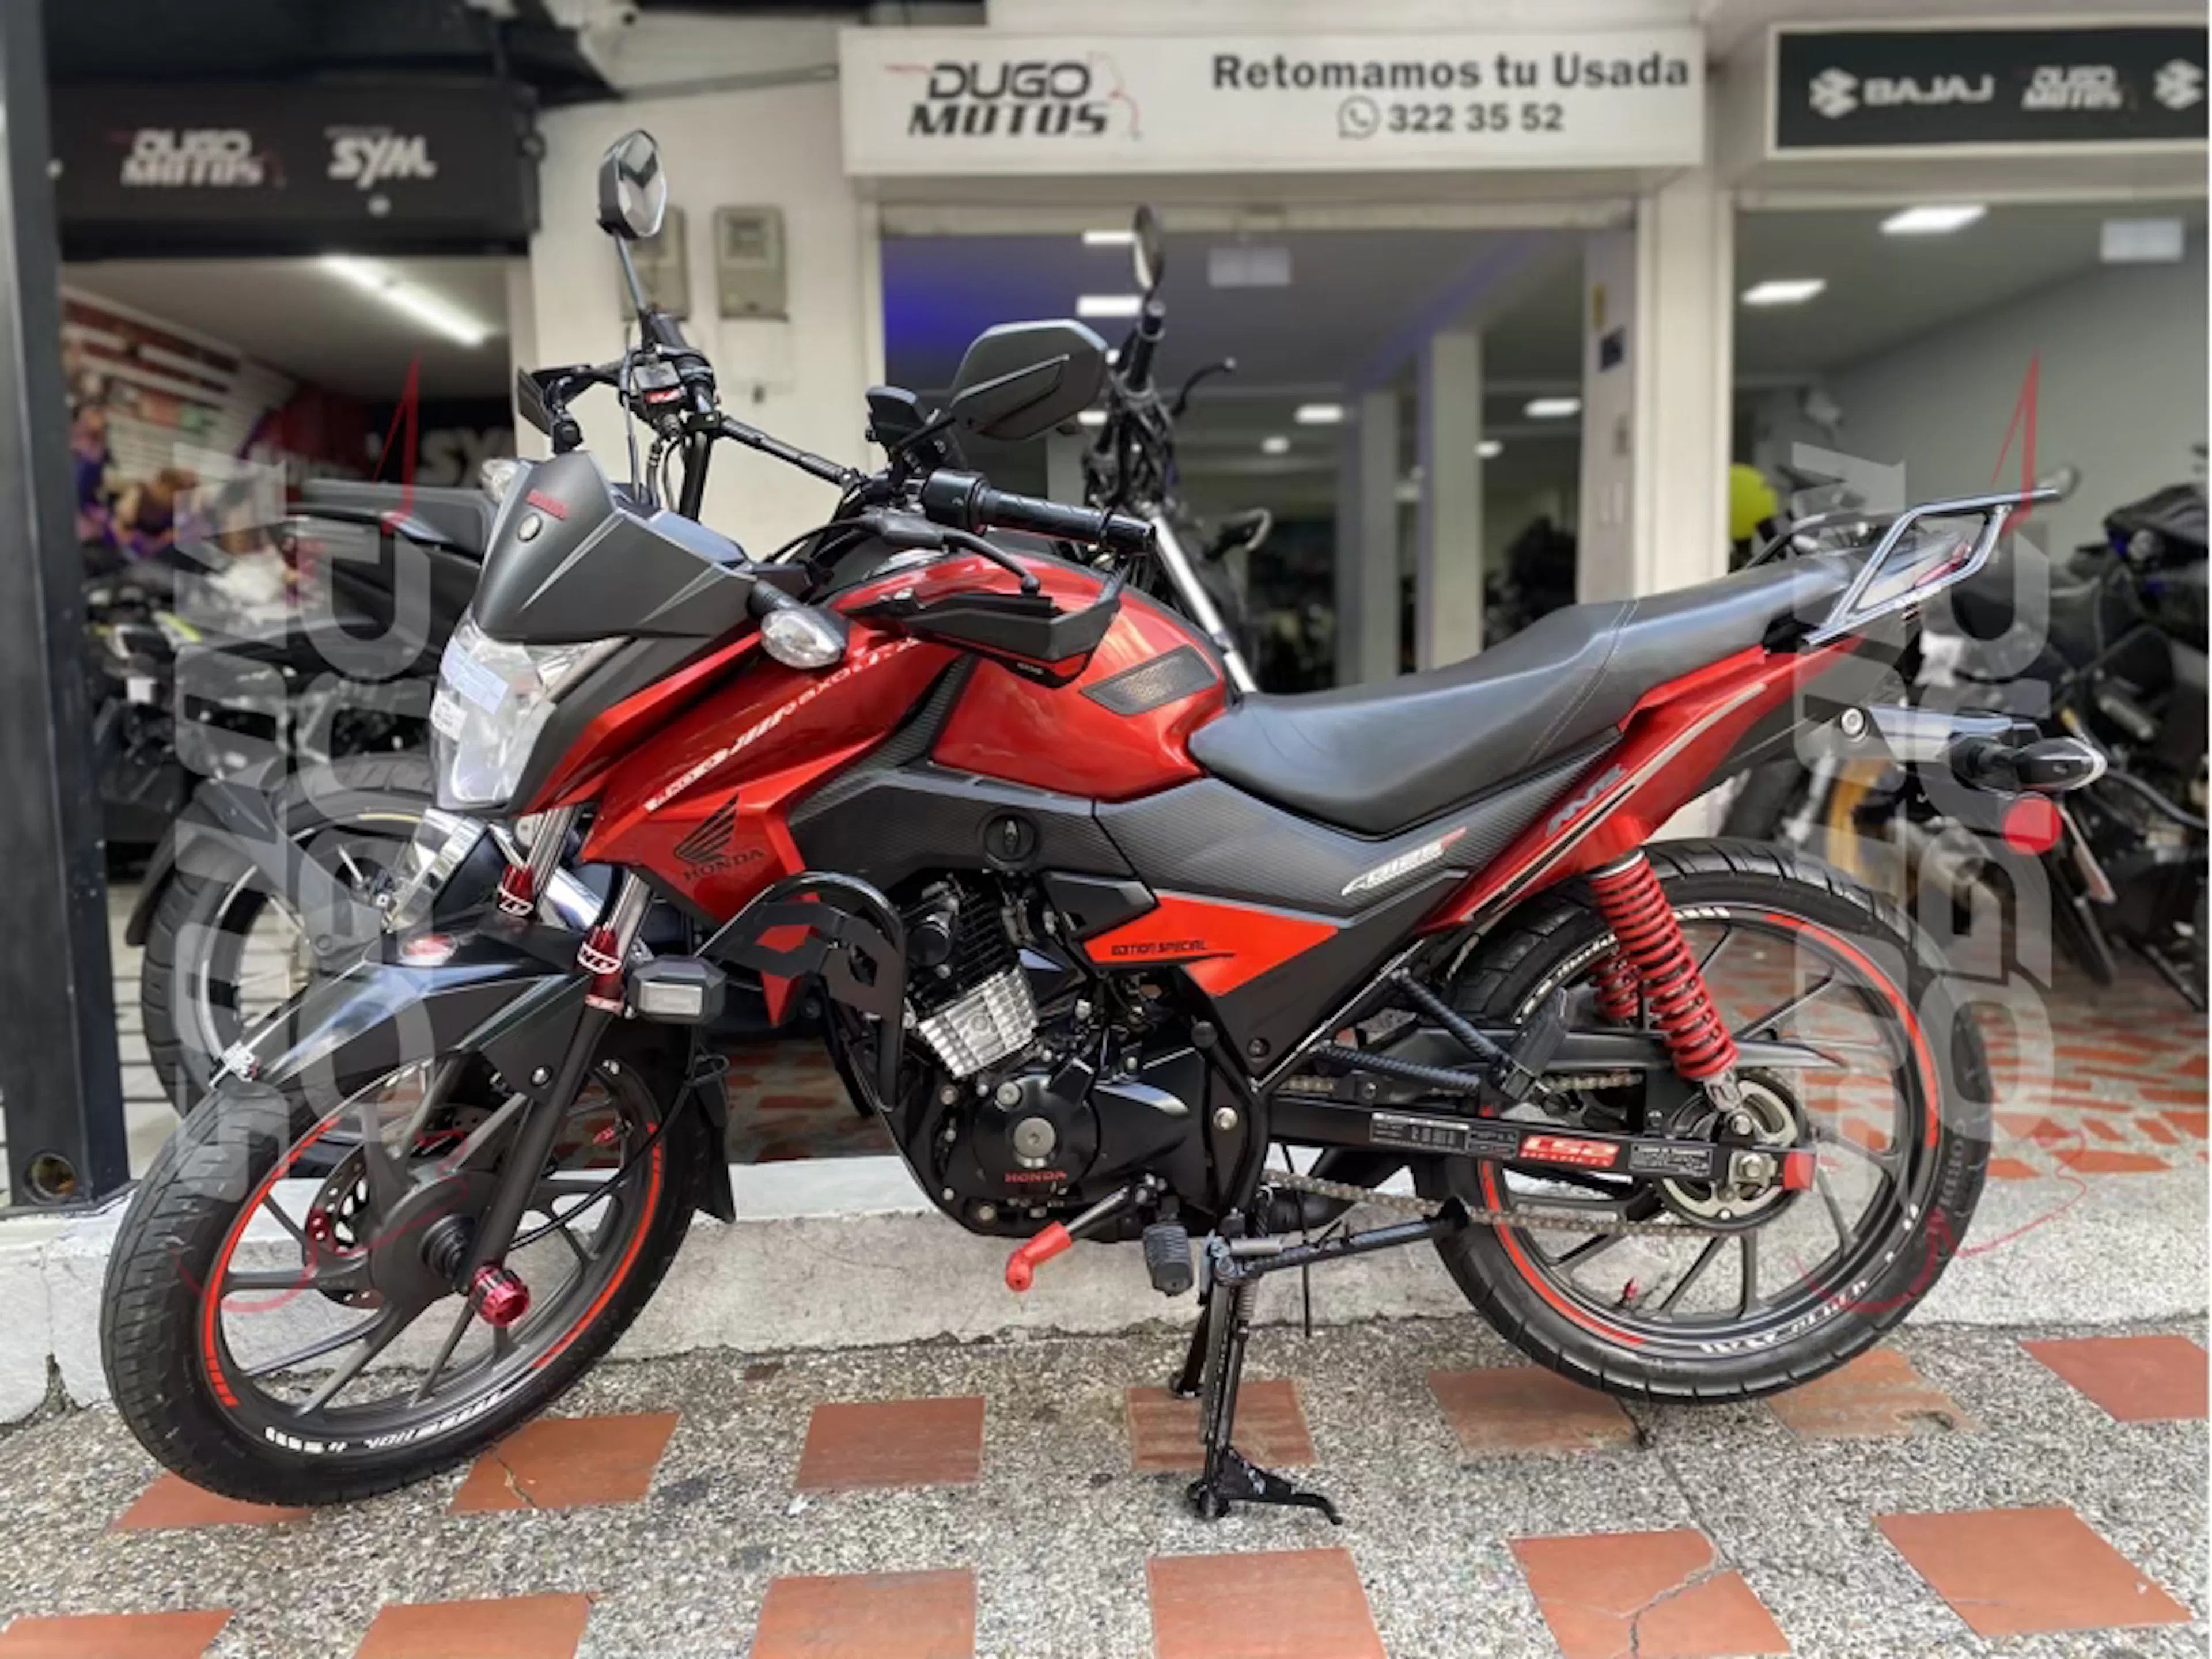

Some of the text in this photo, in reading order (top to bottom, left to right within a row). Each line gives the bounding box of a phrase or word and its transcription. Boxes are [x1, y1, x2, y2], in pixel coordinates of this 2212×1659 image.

[927, 61, 1091, 100] DUGO
[1212, 51, 1690, 90] Retomamos tu Usada
[1863, 73, 1995, 107] BAJAJ
[908, 101, 1109, 138] MOTOS
[1388, 103, 1566, 132] 322 35 52
[326, 135, 438, 191] SYM
[417, 426, 514, 487] SY
[683, 849, 765, 881] HONDA
[1157, 940, 1208, 953] SPECIAL
[1004, 1170, 1067, 1183] HONDA
[1925, 1118, 1968, 1240] CORDIAL
